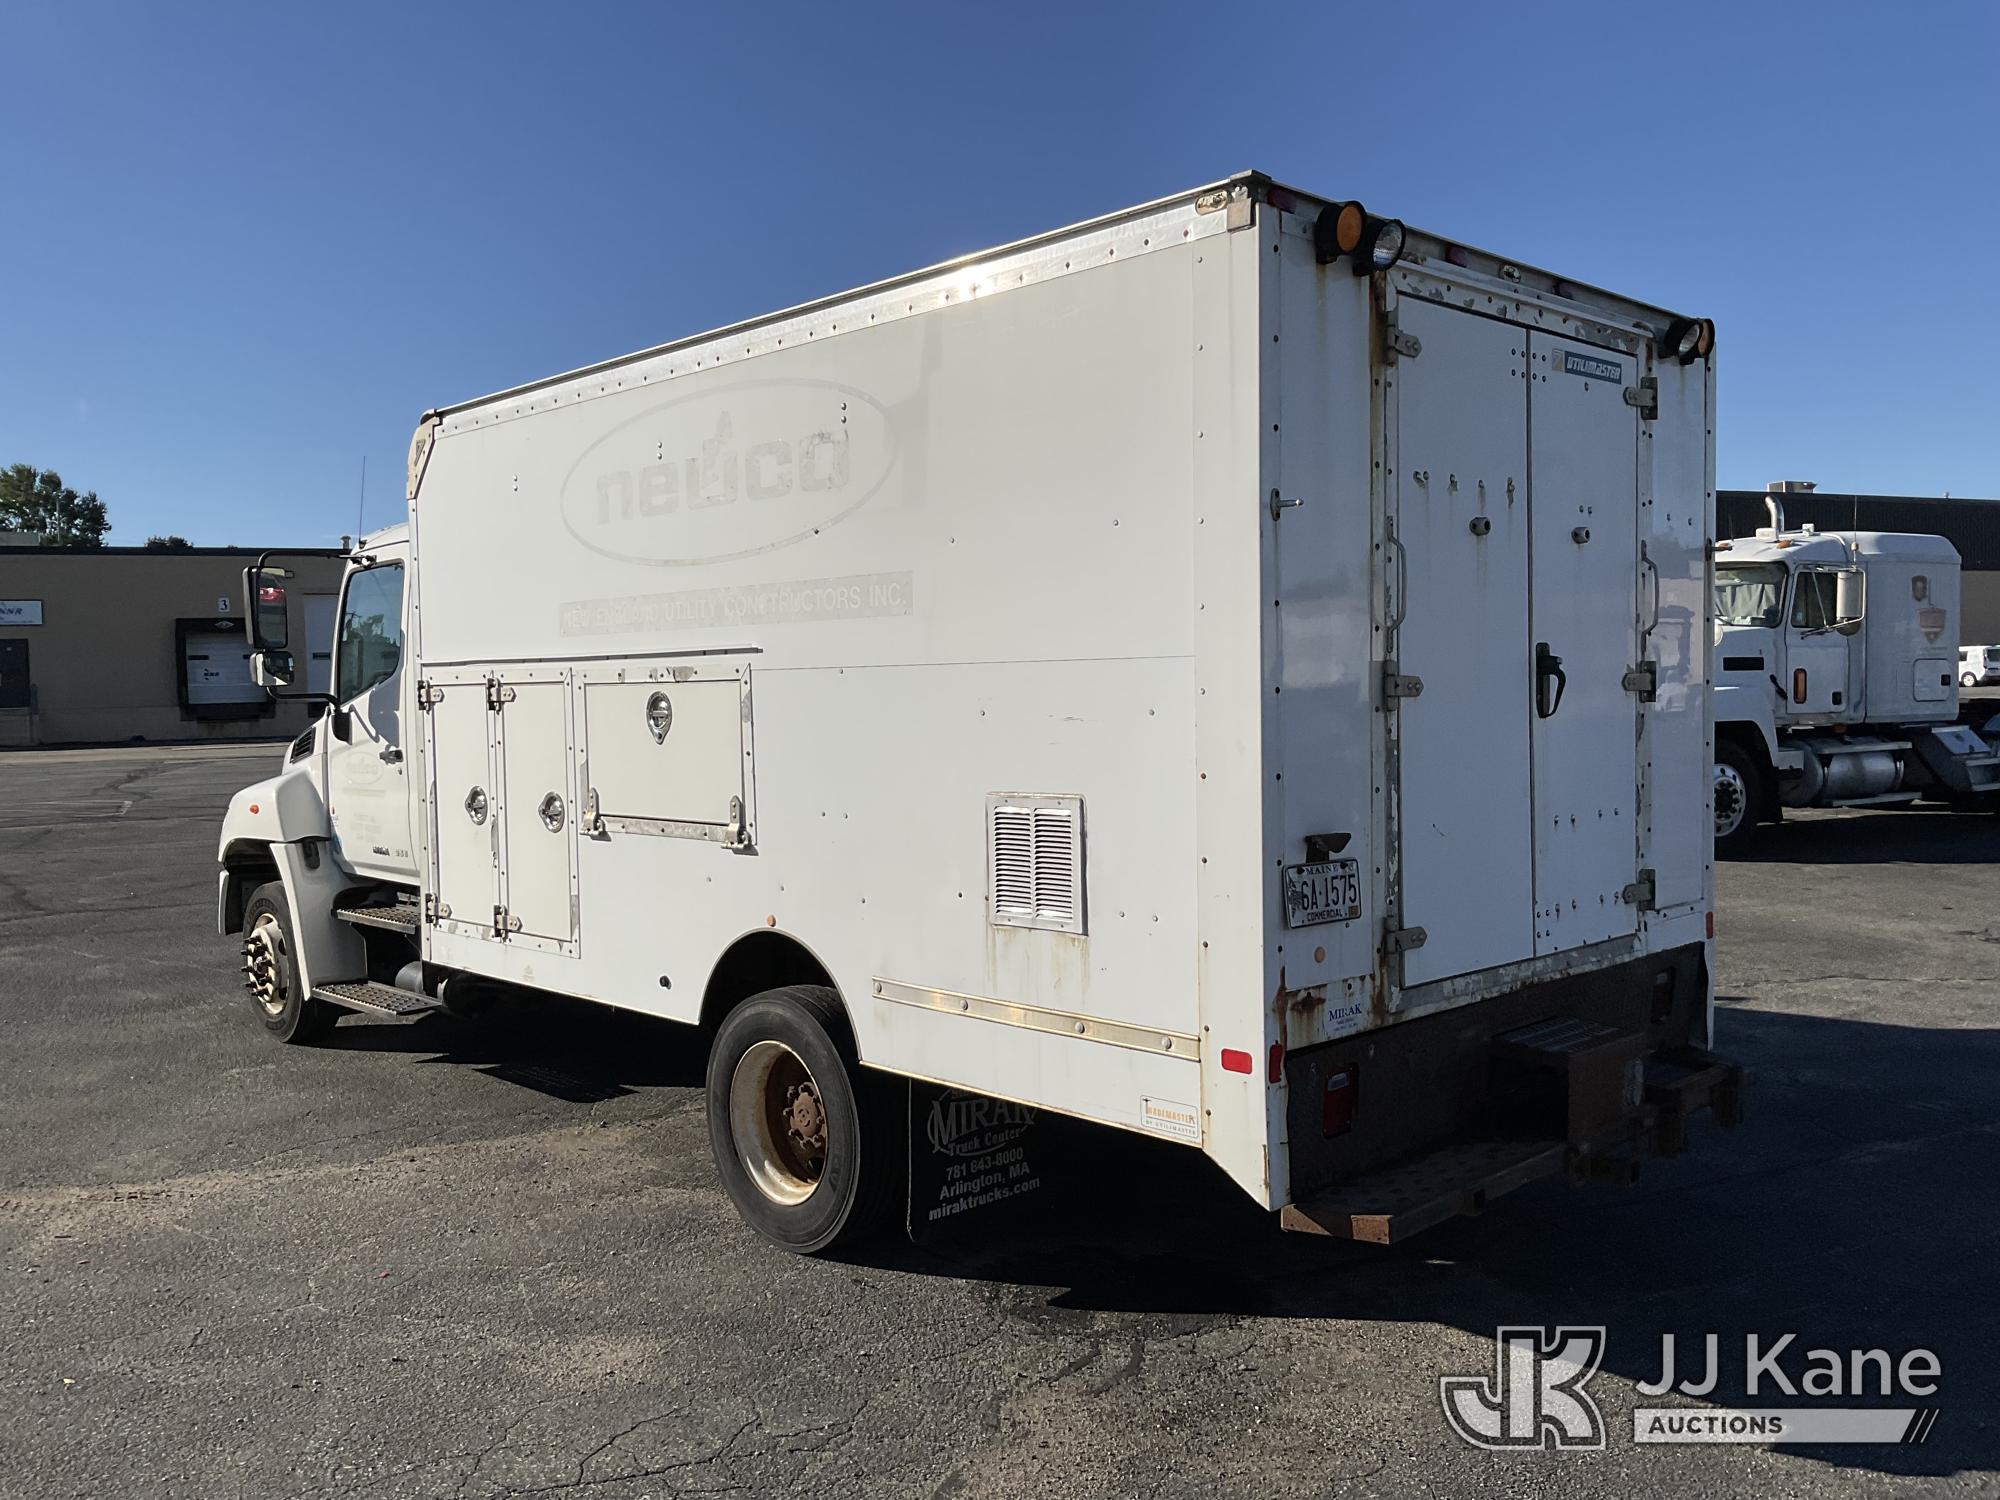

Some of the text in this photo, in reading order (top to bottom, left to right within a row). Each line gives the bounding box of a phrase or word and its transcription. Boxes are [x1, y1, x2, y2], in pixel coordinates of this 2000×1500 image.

[1566, 356, 1621, 380] UTILIMASTER
[220, 599, 228, 611] 3
[665, 598, 717, 622] UTILITY
[869, 582, 907, 608] INC.
[1305, 864, 1339, 875] MAINE
[1307, 908, 1343, 922] COMMERCIAL
[947, 1128, 1022, 1157] Truck Center
[946, 1147, 1024, 1181] 781 643-8000
[1009, 1161, 1030, 1178] MA
[928, 1177, 1041, 1221] miraktrucks.com
